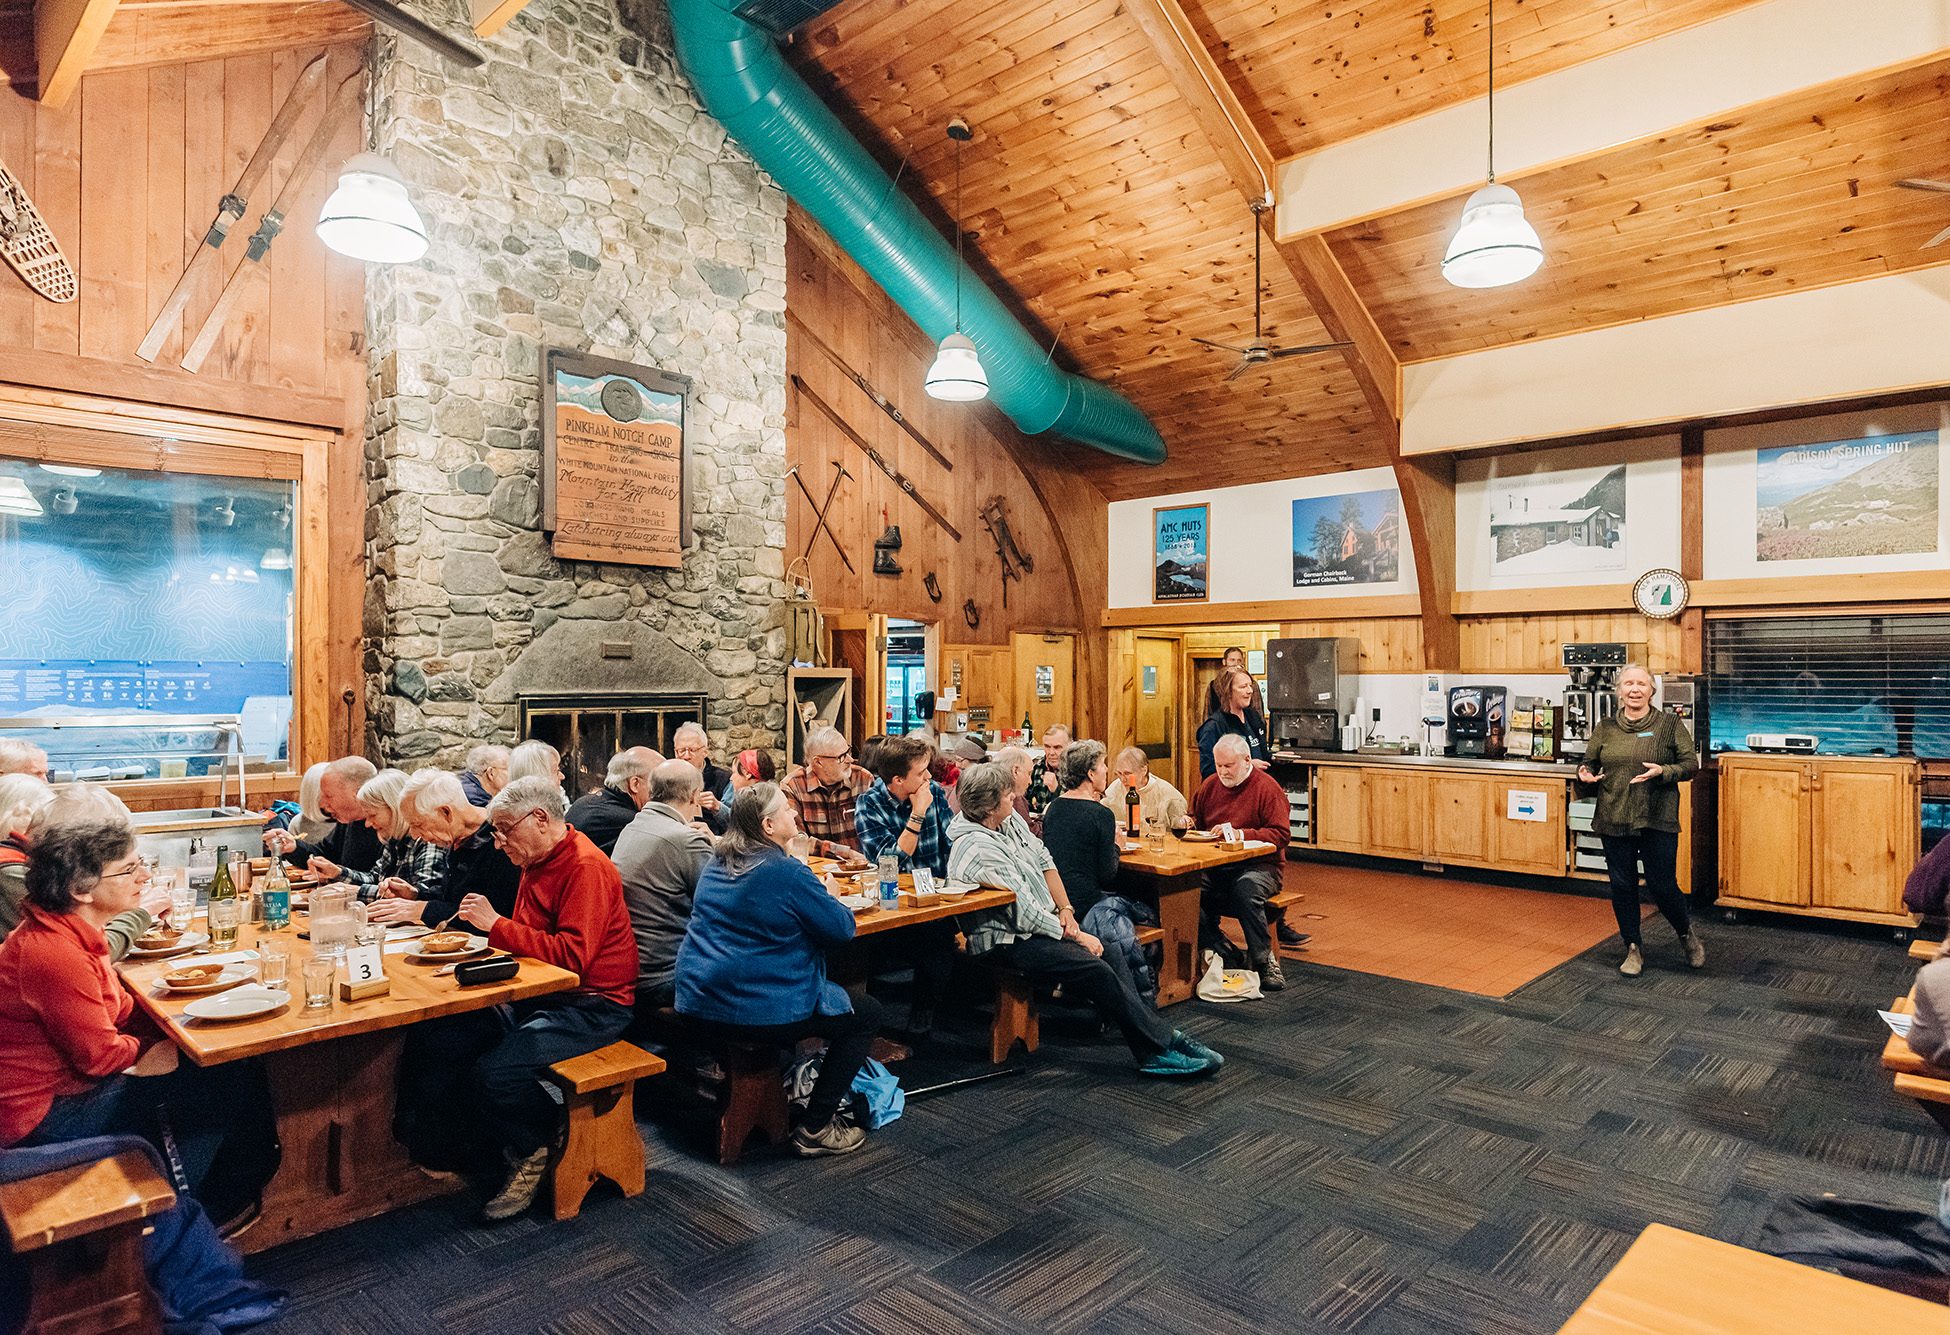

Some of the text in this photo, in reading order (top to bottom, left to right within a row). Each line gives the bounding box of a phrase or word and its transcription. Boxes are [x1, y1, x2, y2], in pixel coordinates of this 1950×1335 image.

[565, 419, 672, 449] PINKHAM NOTCH CAMP
[1838, 444, 1881, 459] SPRING
[1886, 441, 1911, 454] HUT
[620, 454, 634, 464] the
[558, 457, 679, 484] WHITE MOUNTAIN NATIONAL FOREST
[559, 468, 679, 501] Mountain Hospitality
[595, 486, 645, 504] for All
[614, 513, 629, 522] AND
[631, 516, 665, 527] SUPPLIES
[641, 508, 665, 518] MEALS
[560, 521, 679, 544] Latchstring always out
[1161, 520, 1202, 533] AMC HUTS
[1162, 532, 1200, 543] 125 YEARS
[1323, 569, 1347, 577] Chairback
[1651, 574, 1683, 591] HAMPSHIRE
[360, 964, 371, 979] 3
